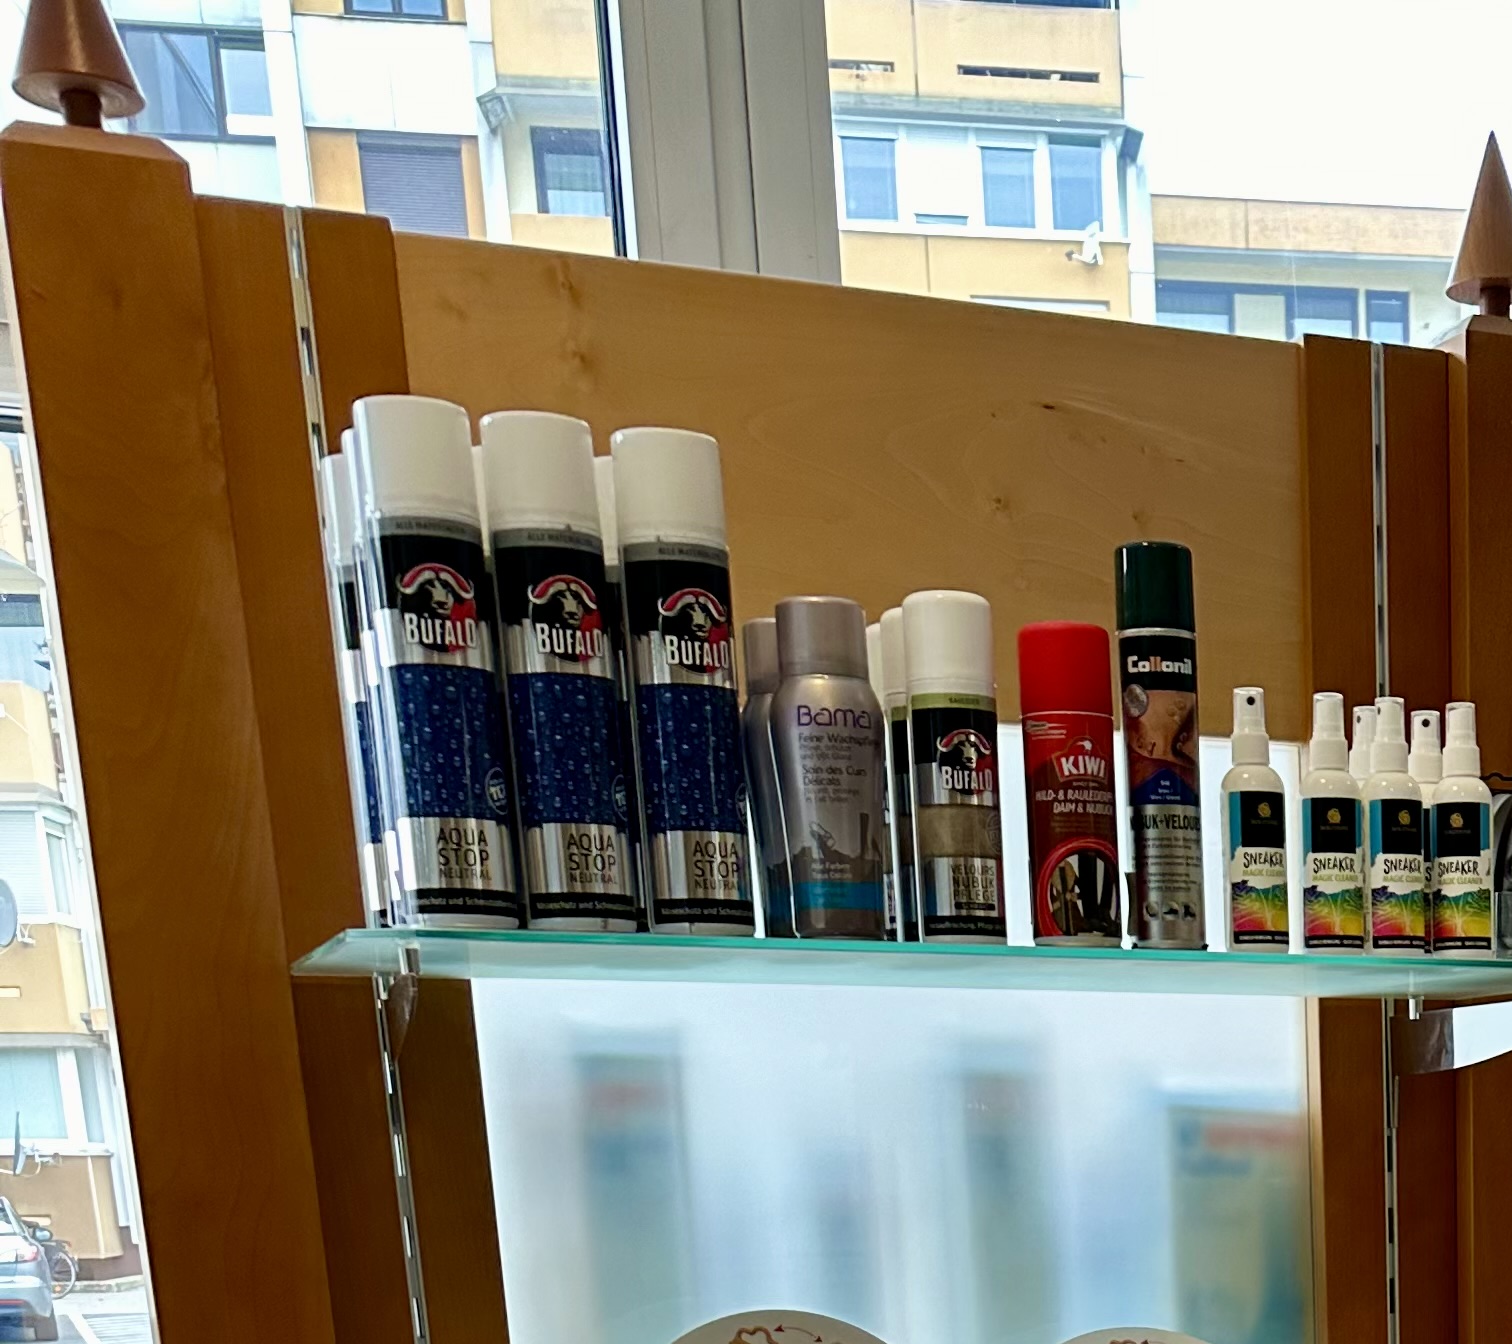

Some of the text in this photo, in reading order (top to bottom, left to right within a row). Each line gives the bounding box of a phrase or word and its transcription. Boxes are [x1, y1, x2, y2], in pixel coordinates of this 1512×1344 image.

[1127, 654, 1193, 676] Collonil
[797, 704, 873, 729] Bama
[1060, 755, 1106, 778] KIWI
[438, 827, 488, 848] AQUA
[567, 833, 615, 853] AQUA
[438, 848, 490, 867] STOP
[694, 840, 739, 859] AQUA
[568, 852, 617, 872] STOP
[694, 859, 740, 879] STOP
[1243, 851, 1284, 869] SNEAKER
[1313, 856, 1356, 874] SNEAKER
[1383, 858, 1422, 876] SNEAKER
[1438, 859, 1480, 877] SNEAKER
[950, 863, 995, 877] VELOURS
[952, 875, 995, 889] NUBUK
